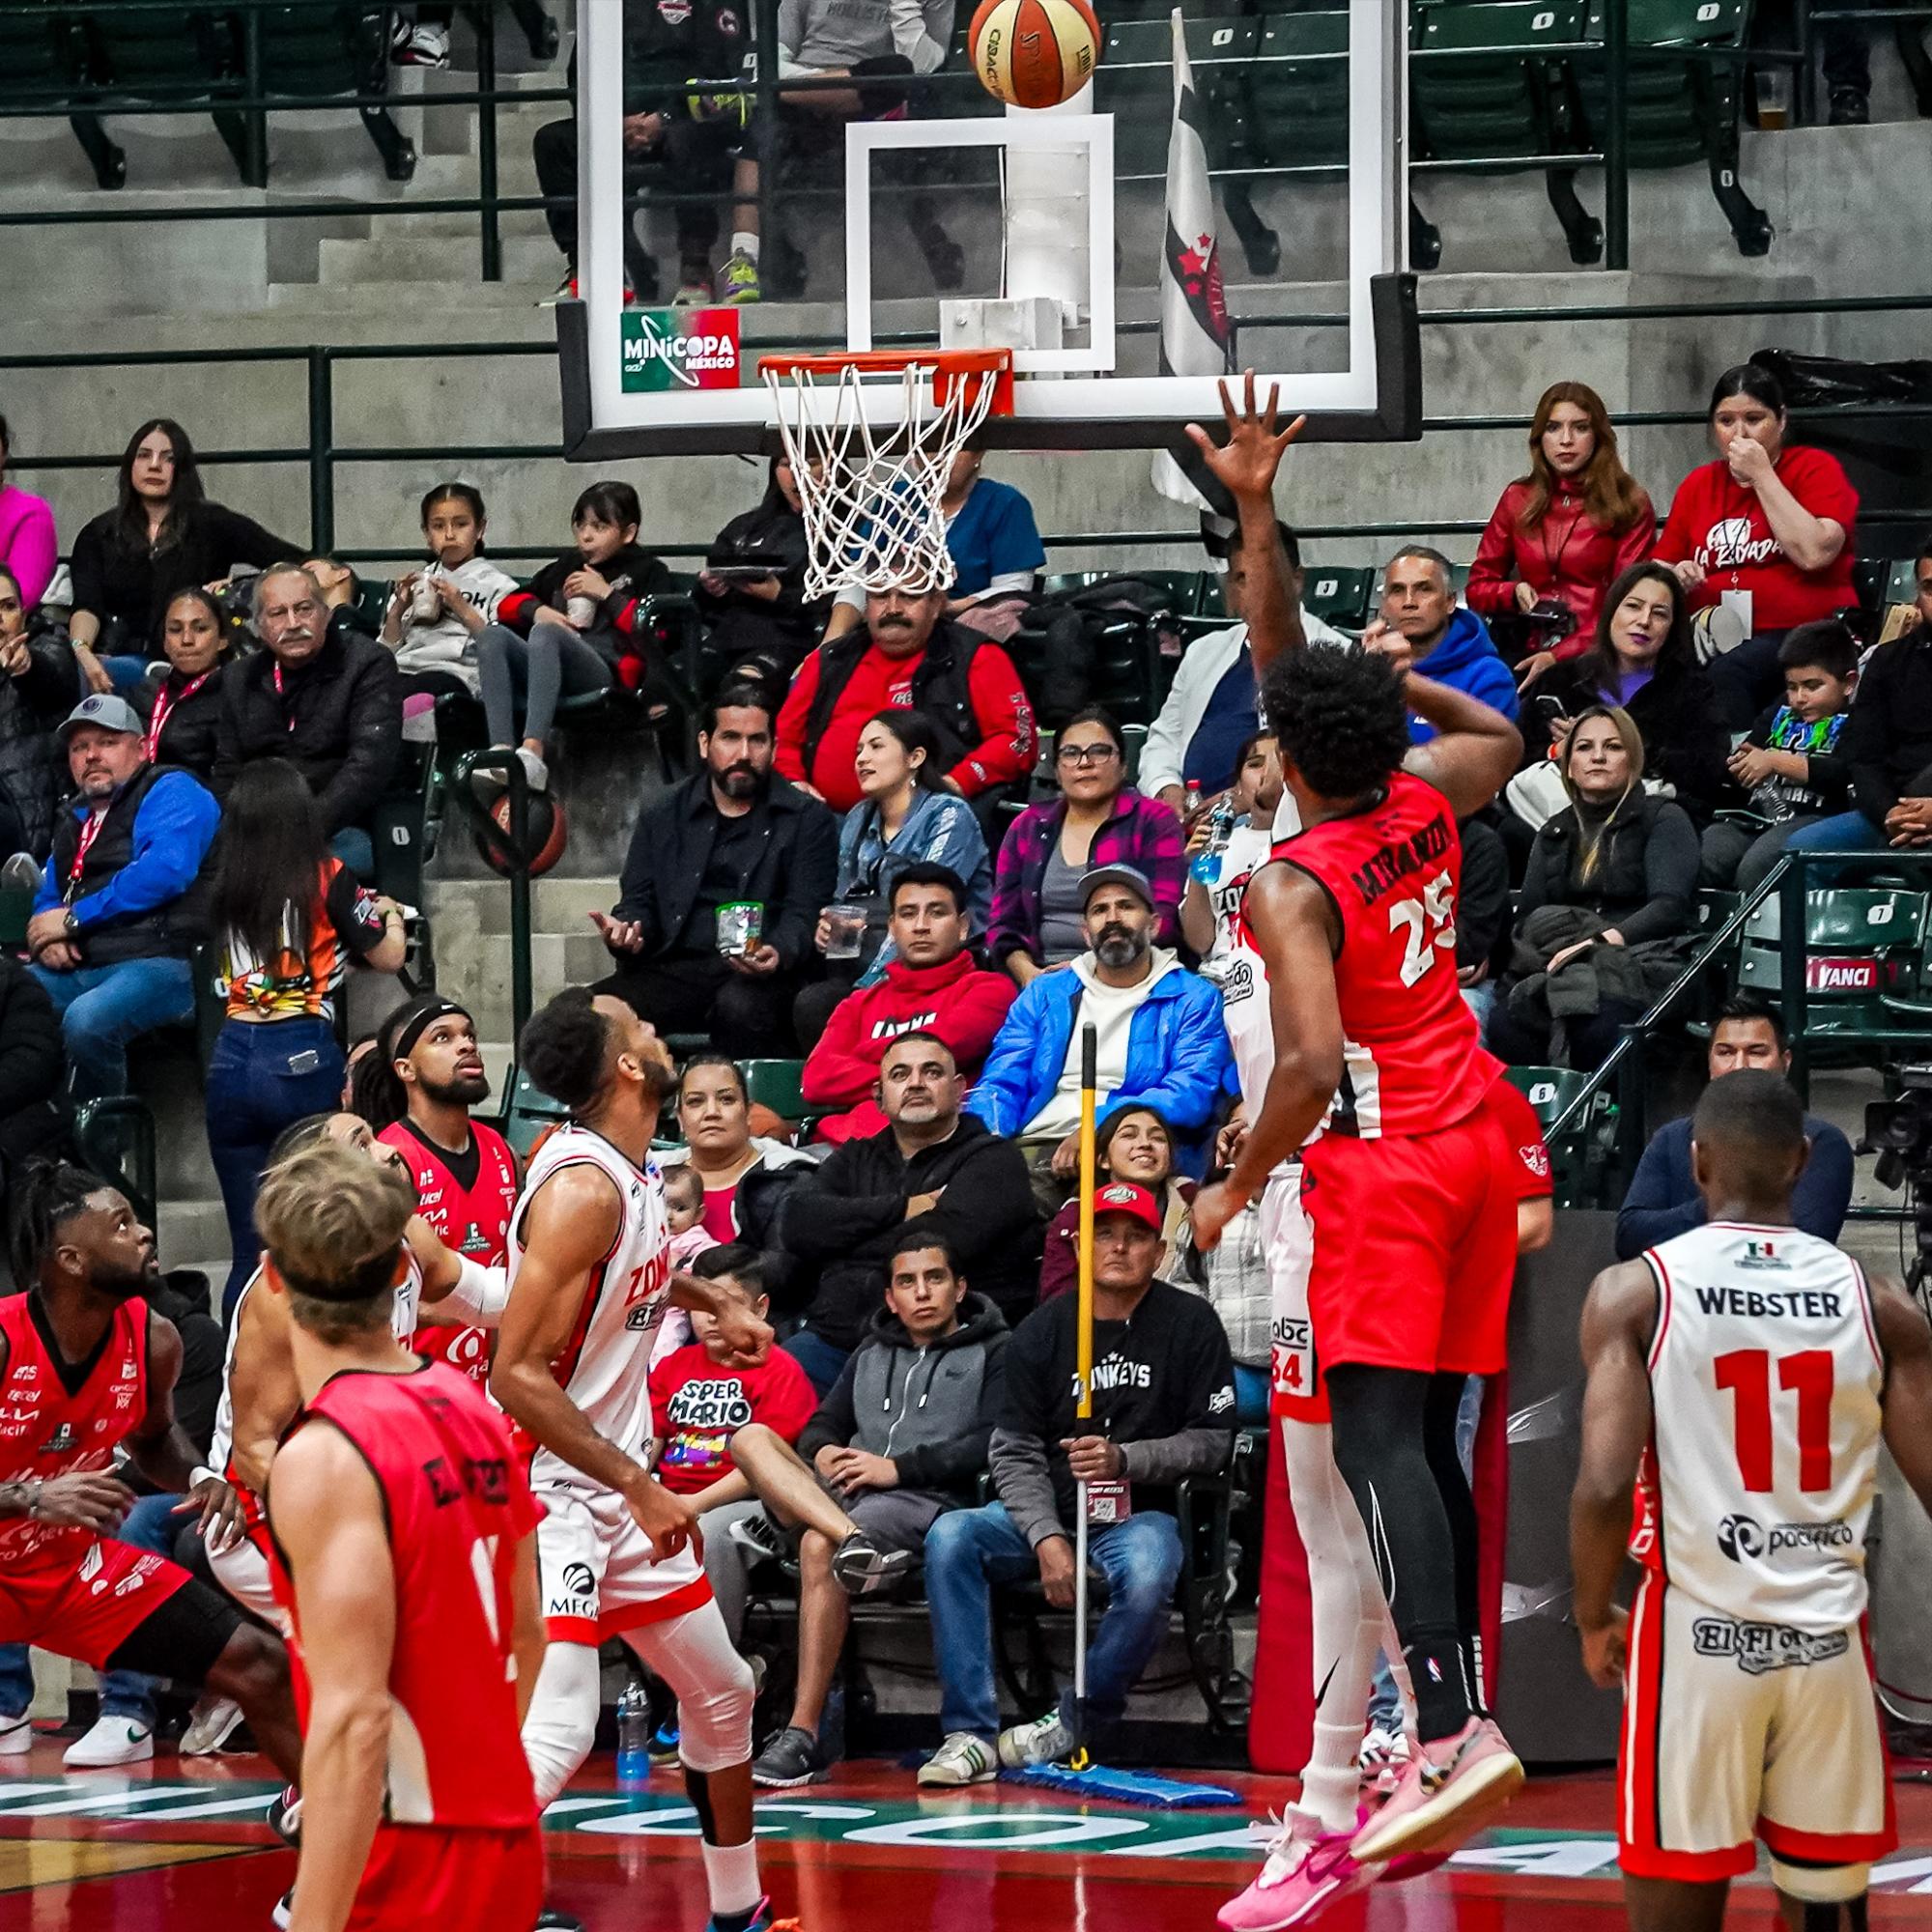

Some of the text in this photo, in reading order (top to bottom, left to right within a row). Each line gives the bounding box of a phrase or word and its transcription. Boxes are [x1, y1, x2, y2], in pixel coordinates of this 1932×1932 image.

[1388, 867, 1457, 989] 25
[1695, 1287, 1842, 1318] WEBSTER
[668, 1396, 751, 1425] MARIO
[1714, 1350, 1833, 1492] 11
